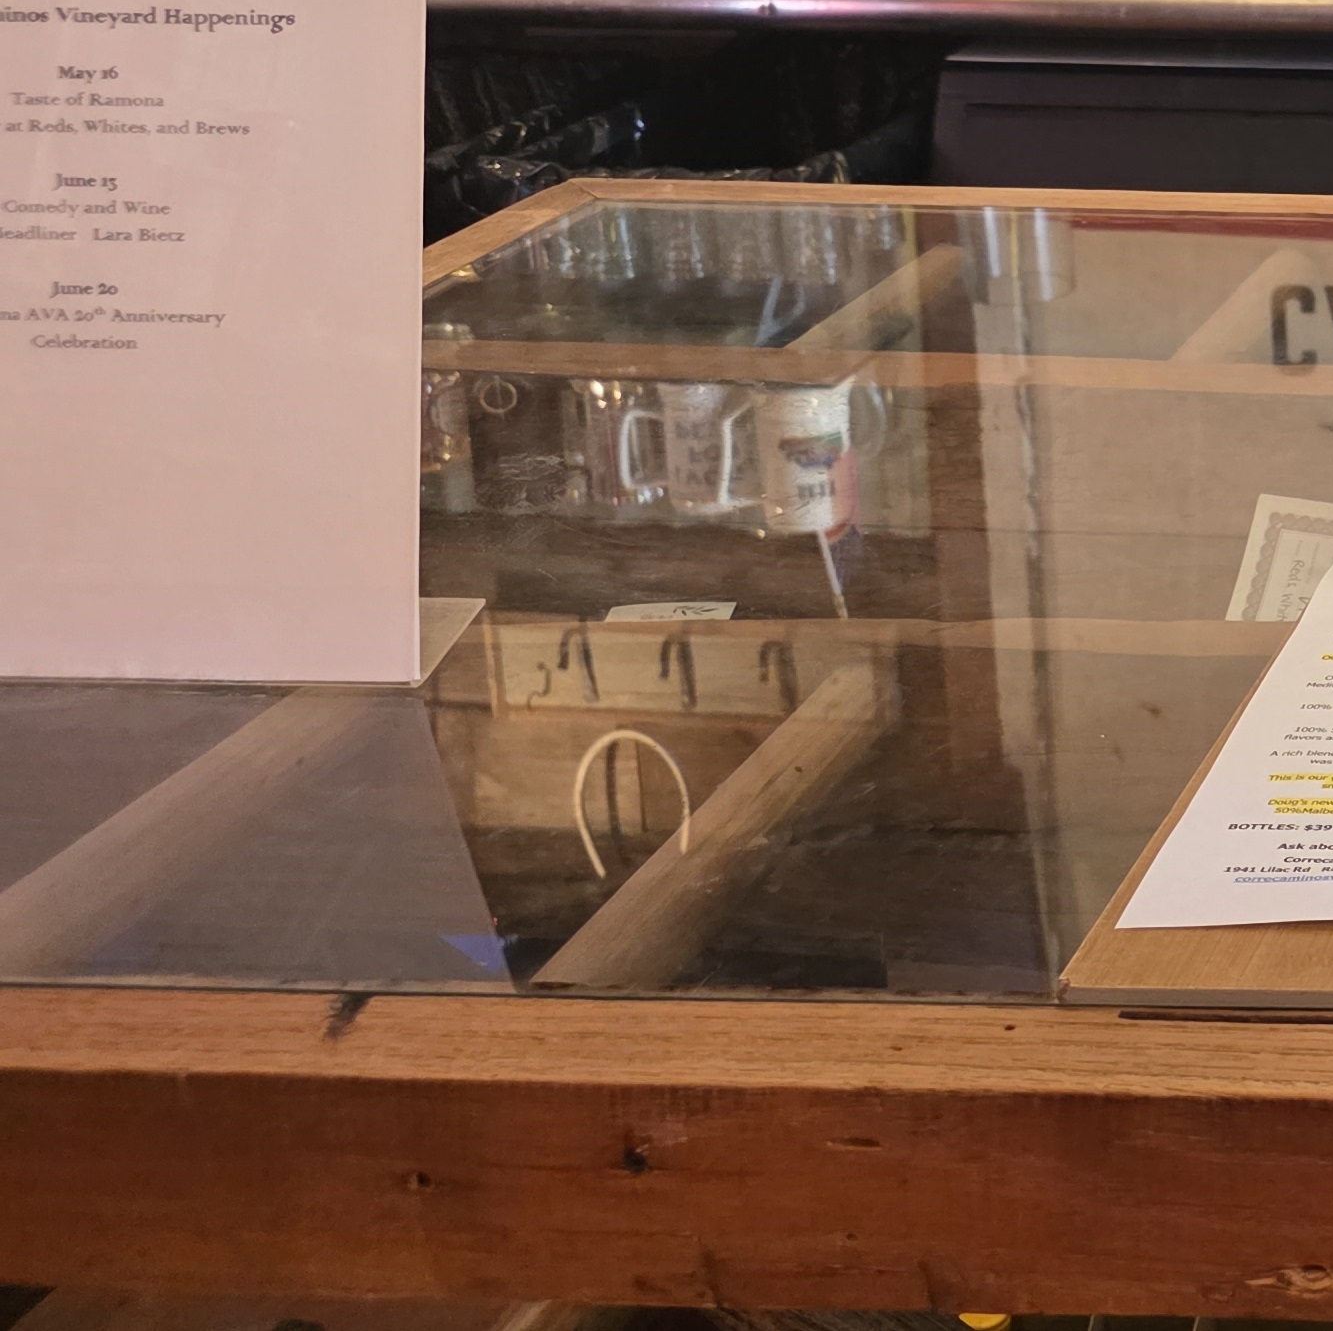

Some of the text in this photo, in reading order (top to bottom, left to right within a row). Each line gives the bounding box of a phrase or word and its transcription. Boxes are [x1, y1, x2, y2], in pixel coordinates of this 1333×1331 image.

[55, 6, 157, 29] Vineyard
[163, 8, 296, 32] Happenings
[57, 65, 119, 83] May 16
[11, 91, 164, 107] Taste of Ramona
[6, 119, 250, 136] at Reds, Whites, and Brews
[51, 173, 97, 191] June
[2, 199, 171, 218] Comedy and Wine
[92, 228, 133, 241] Lara
[50, 281, 118, 298] June 20
[26, 308, 70, 322] AVA
[74, 306, 106, 322] 20th
[112, 309, 226, 328] Anniversary
[30, 334, 138, 350] Celebration
[1228, 823, 1300, 831] BOTTLES:
[1304, 823, 1332, 832] $39
[1277, 842, 1306, 850] Ask
